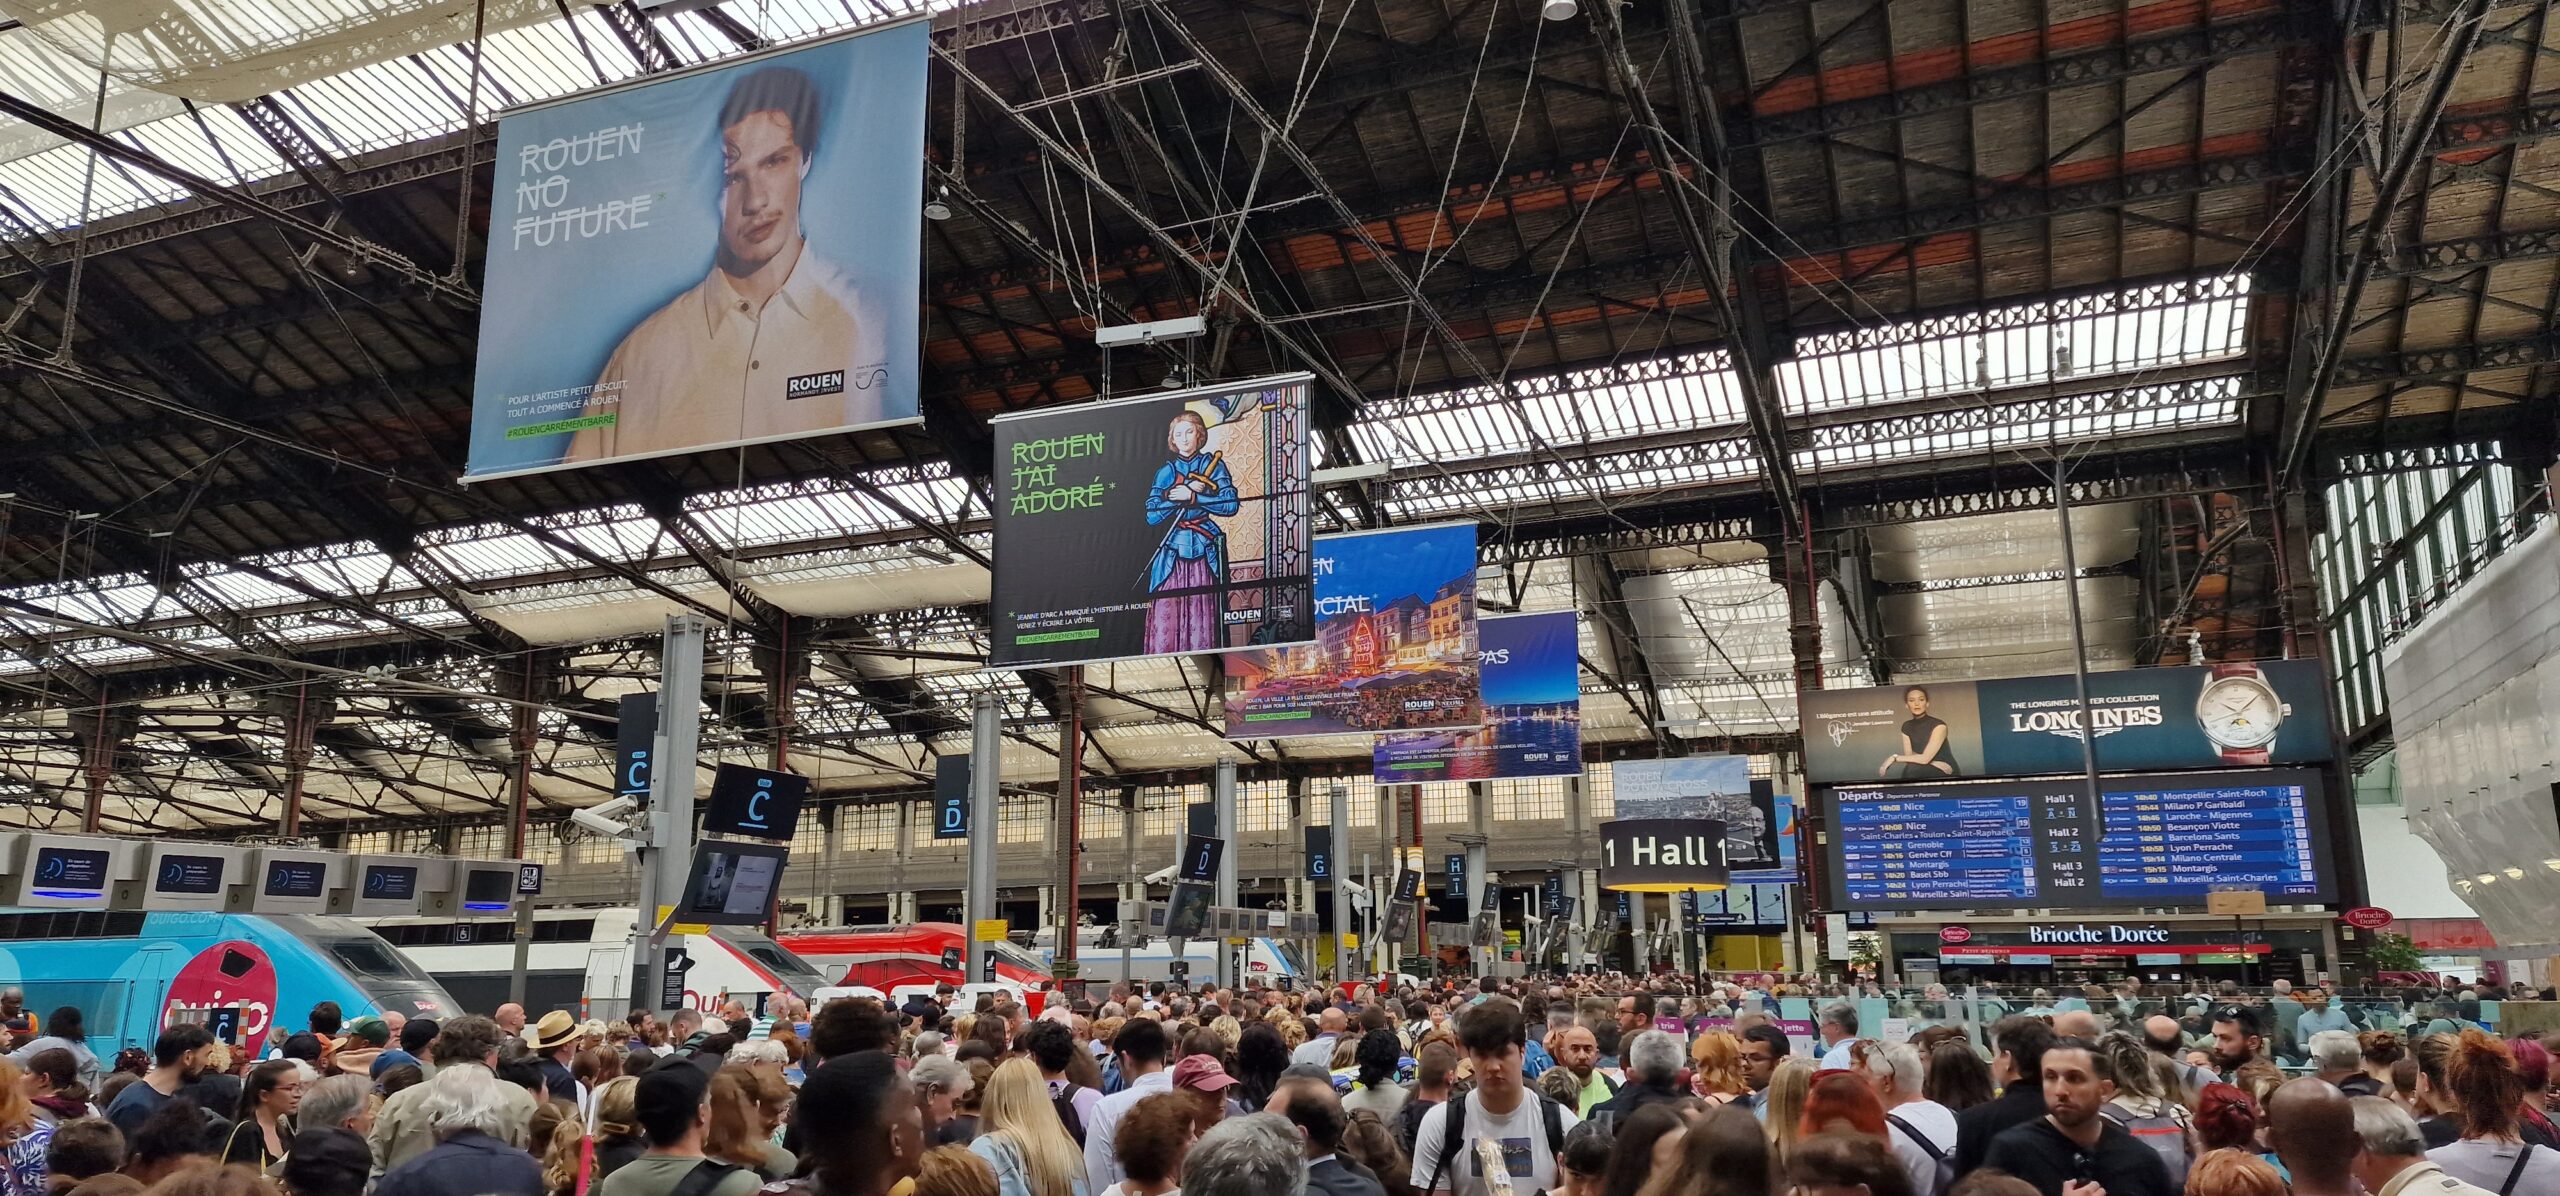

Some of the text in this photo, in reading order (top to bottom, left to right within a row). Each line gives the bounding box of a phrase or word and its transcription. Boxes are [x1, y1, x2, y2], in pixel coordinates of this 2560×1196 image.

[519, 122, 645, 176] ROUEN
[516, 175, 570, 213] NO
[513, 194, 652, 250] FUTURE
[790, 373, 842, 392] ROUEN
[508, 396, 530, 406] POUR
[531, 388, 569, 402] L'ARTISTE
[570, 385, 593, 396] PETIT
[507, 408, 528, 418] TOUT
[530, 408, 535, 416] A
[537, 398, 582, 414] COMMENCÉ
[1012, 432, 1105, 464] ROUEN
[1011, 464, 1057, 490] J'AI
[1010, 476, 1104, 516] ADORÉ
[1016, 613, 1040, 621] JEANNE
[1064, 607, 1090, 616] MARQUÉ
[1224, 610, 1261, 620] ROUEN
[1016, 622, 1036, 630] VENEZ
[1042, 618, 1064, 627] ÉCRIRE
[1404, 700, 1434, 708] ROUEN
[2028, 700, 2070, 708] LONGINES
[2070, 698, 2105, 706] MTER
[2106, 694, 2160, 704] COLLECTION
[2010, 706, 2162, 732] LONGINES
[628, 761, 647, 788] C
[1838, 791, 1884, 802] Départs
[2045, 794, 2074, 803] Hall 1
[2163, 792, 2216, 801] Montpellier
[748, 791, 770, 821] C
[946, 808, 961, 828] D
[1859, 812, 1912, 821] Saint-Charles
[2209, 811, 2253, 820] Migennes
[1906, 822, 1926, 830] Nice
[2167, 823, 2210, 832] Besançon
[1861, 832, 1913, 840] Saint-Charles
[2049, 828, 2079, 837] Hall 2
[1907, 841, 1944, 849] Grenoble
[2170, 844, 2191, 853] Lyon
[2194, 843, 2233, 851] Perrache
[1606, 836, 1726, 867] 1 Hall 1
[1940, 850, 1952, 858] Cff
[1198, 851, 1208, 870] D
[2171, 854, 2201, 862] Milano
[1314, 860, 1324, 873] G
[1451, 862, 1460, 872] H
[1910, 861, 1949, 870] Montargis
[2053, 862, 2082, 870] Hall 3
[2173, 865, 2217, 874] Montargis
[1550, 882, 1557, 891] J
[1912, 881, 1930, 889] Lyon
[2054, 878, 2085, 886] Hall 2
[1552, 898, 1559, 908] K
[2355, 911, 2386, 919] Brioche
[2359, 917, 2382, 925] Dorée
[2030, 925, 2169, 942] Brioche Dorée
[216, 1022, 229, 1041] C
[1784, 1024, 1804, 1033] jette
